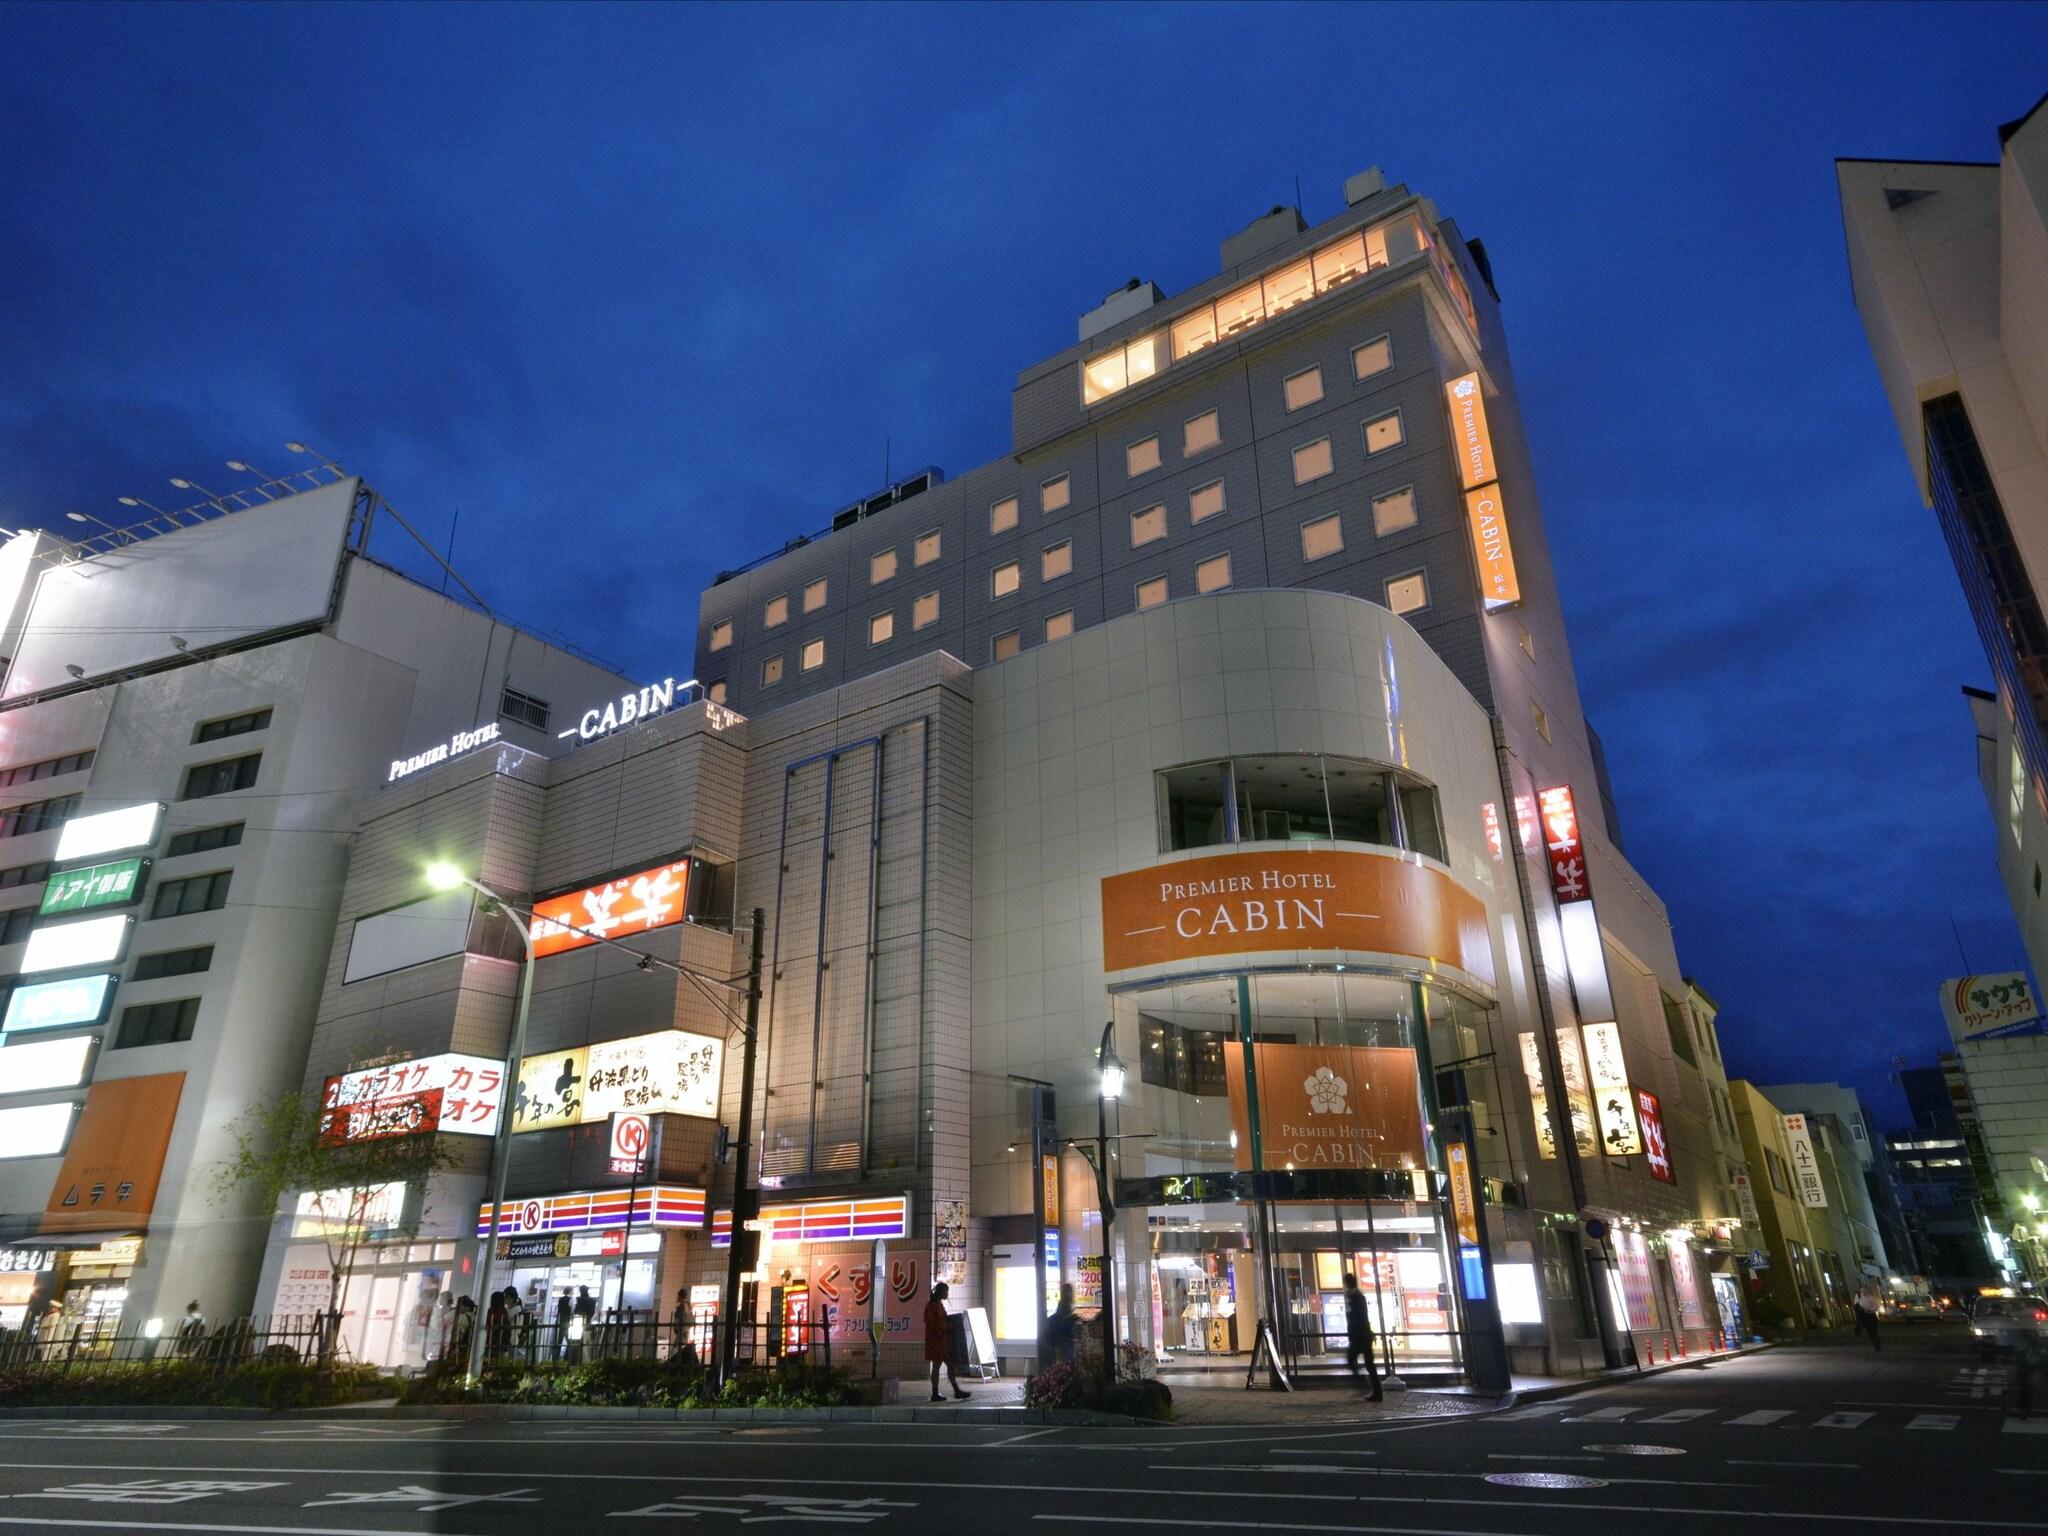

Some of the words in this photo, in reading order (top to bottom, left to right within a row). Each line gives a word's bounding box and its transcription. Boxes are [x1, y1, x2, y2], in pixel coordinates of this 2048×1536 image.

[1461, 398, 1477, 442] PREMIER
[1469, 444, 1485, 481] HOTEL
[1478, 500, 1503, 561] CABIN
[578, 678, 674, 739] CABIN
[388, 744, 448, 781] PREMIER
[450, 722, 501, 755] HOTEL
[1160, 876, 1253, 902] PREMIER
[1260, 870, 1337, 890] HOTEL
[1176, 898, 1325, 938] CABIN
[448, 1066, 500, 1093] カラ
[446, 1097, 496, 1123] オケ
[1282, 1124, 1335, 1138] PREMIER
[1339, 1125, 1379, 1139] HOTEL
[1292, 1143, 1375, 1164] CABIN
[1795, 1140, 1821, 1202] 八十二銀行
[61, 1181, 134, 1206] ムラタ
[817, 1258, 922, 1305] くすり
